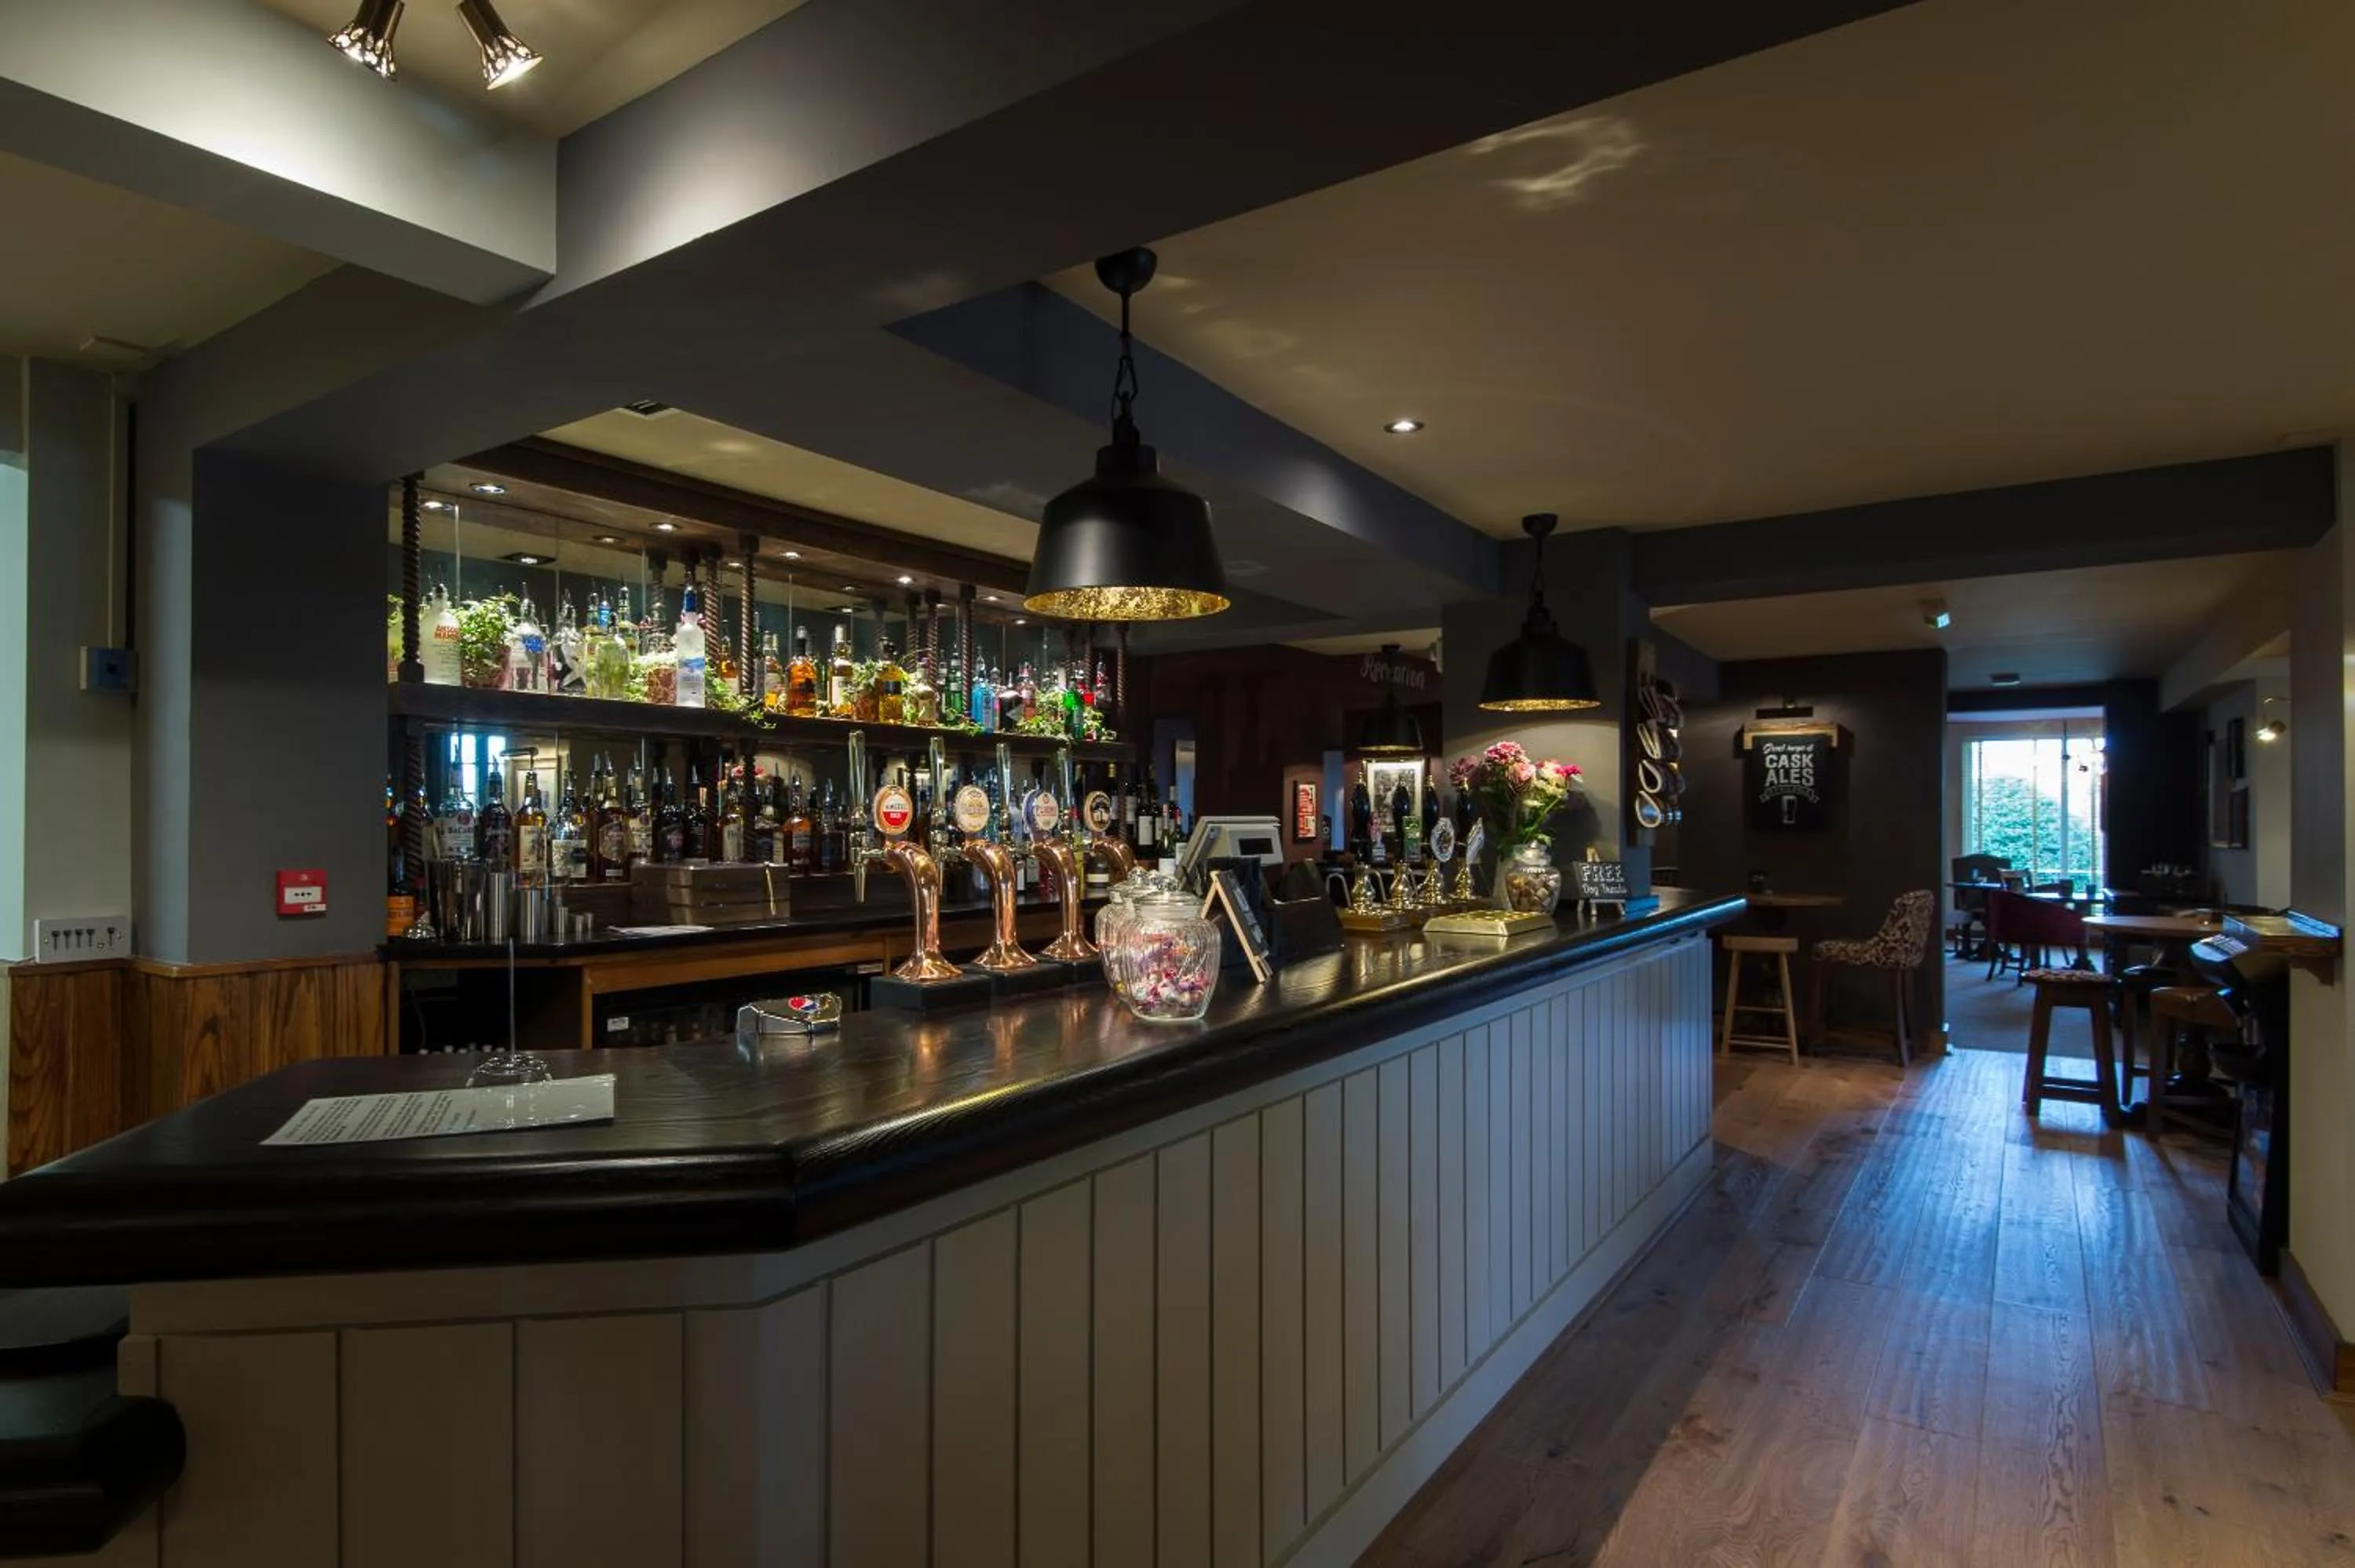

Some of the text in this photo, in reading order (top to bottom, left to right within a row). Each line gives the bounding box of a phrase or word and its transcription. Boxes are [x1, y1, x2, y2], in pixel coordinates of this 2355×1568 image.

[1765, 753, 1814, 768] CASK
[1765, 768, 1815, 787] ALES
[1579, 863, 1624, 882] FREE
[1582, 883, 1599, 896] Dog
